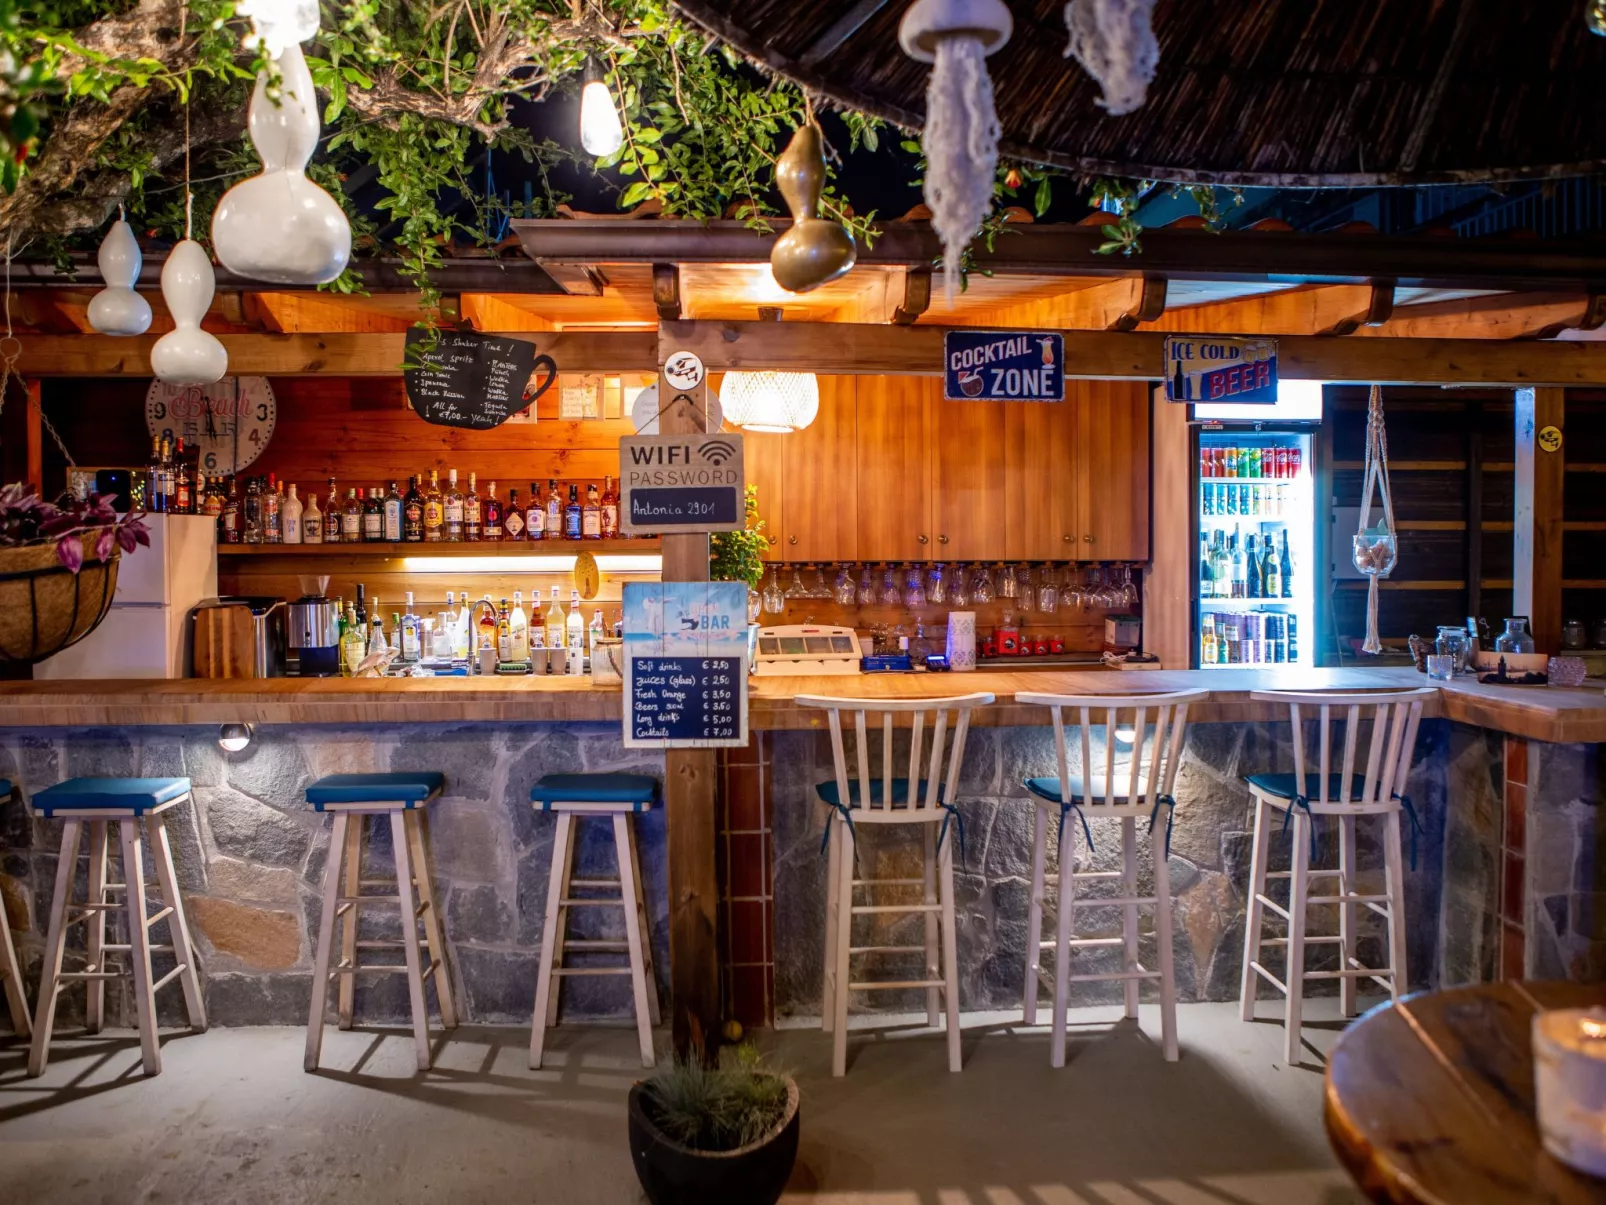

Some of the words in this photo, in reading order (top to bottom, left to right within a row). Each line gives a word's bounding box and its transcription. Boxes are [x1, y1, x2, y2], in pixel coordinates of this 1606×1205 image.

[452, 338, 478, 348] Shaker
[483, 341, 502, 352] Time
[951, 336, 1032, 370] COCKTAIL
[1171, 342, 1194, 360] ICE
[1200, 344, 1240, 360] COLD
[990, 368, 1054, 396] ZONE
[1209, 361, 1270, 400] BEER
[154, 402, 166, 420] 9
[169, 386, 252, 420] Beach
[432, 402, 446, 410] All
[256, 404, 268, 422] 3
[248, 428, 261, 446] 4
[204, 452, 217, 470] 6
[630, 446, 690, 464] WIFI
[630, 470, 738, 486] PASSWORD
[634, 498, 682, 515] Antonia
[688, 502, 715, 516] 2901
[701, 615, 730, 630] BAR
[637, 660, 654, 672] Soft
[658, 662, 682, 671] drinks
[669, 674, 696, 688] (glass)
[712, 676, 730, 686] 2,50
[635, 688, 656, 700] Fresh
[662, 690, 686, 702] Orange
[712, 690, 731, 700] 3,50
[634, 702, 658, 712] Beers
[636, 714, 652, 726] Long
[658, 712, 680, 724] drinks
[713, 716, 732, 724] 5,00
[636, 728, 669, 737] Cocktails
[713, 728, 732, 736] 7,00
